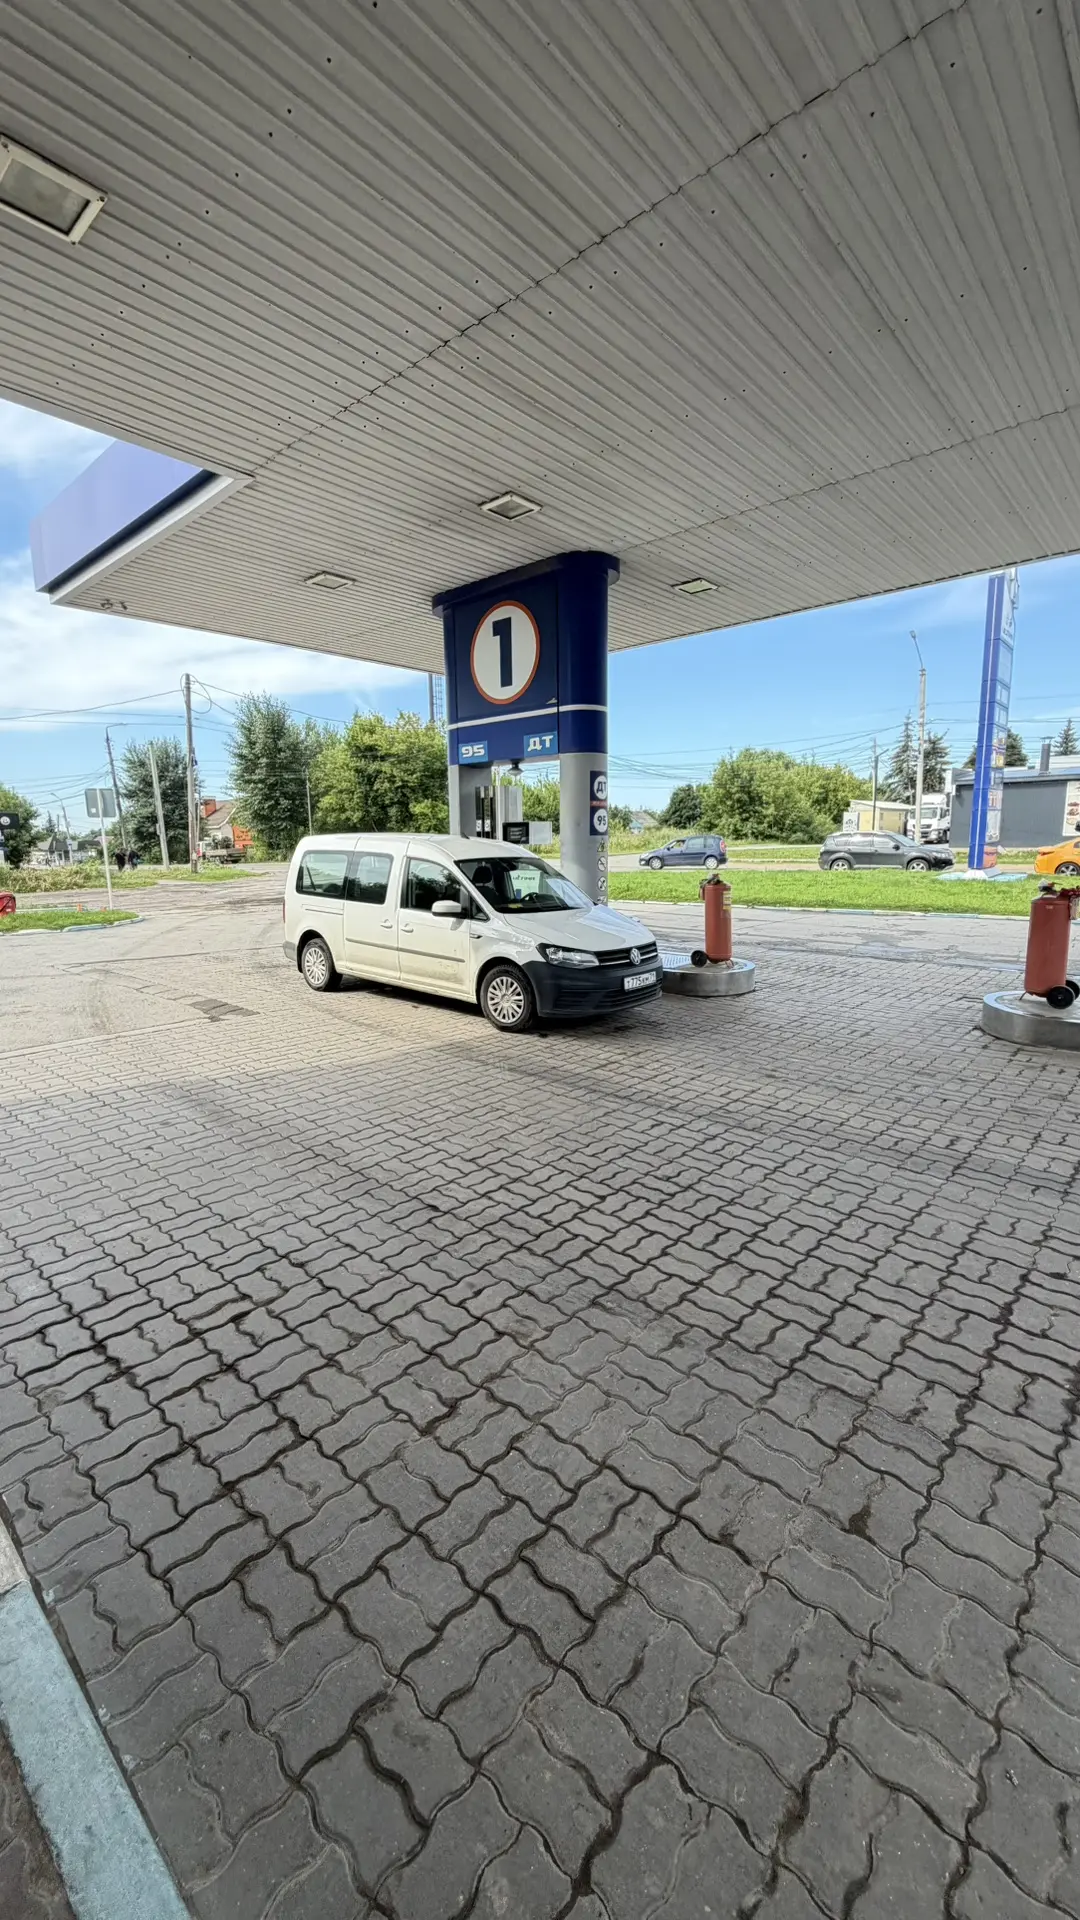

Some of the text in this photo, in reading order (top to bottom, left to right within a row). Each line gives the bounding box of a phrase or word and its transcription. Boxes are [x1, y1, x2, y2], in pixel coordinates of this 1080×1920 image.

[492, 616, 513, 688] 1
[461, 744, 485, 758] 95
[527, 735, 554, 752] ДТ
[597, 815, 607, 826] 95
